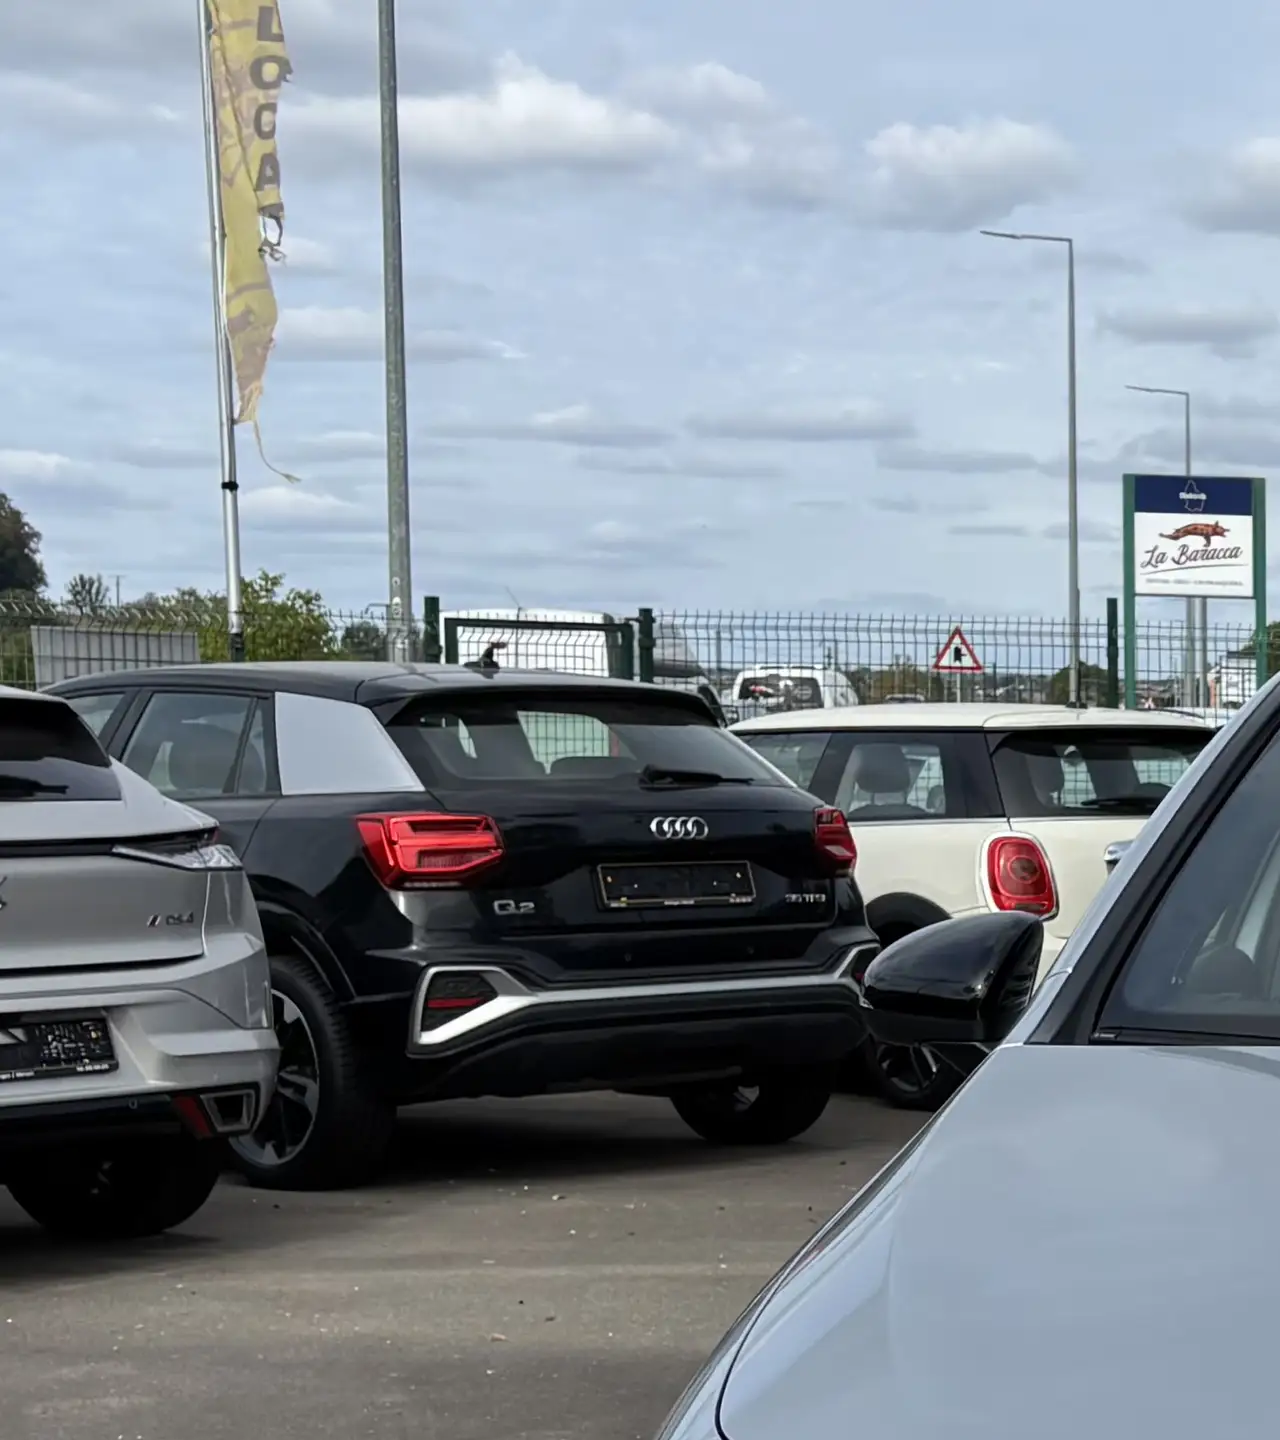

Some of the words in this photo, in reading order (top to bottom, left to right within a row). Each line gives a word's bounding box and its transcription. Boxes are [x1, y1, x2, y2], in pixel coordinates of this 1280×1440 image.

[1140, 544, 1168, 569] La
[1171, 543, 1243, 566] Baracca
[493, 899, 535, 915] Q2
